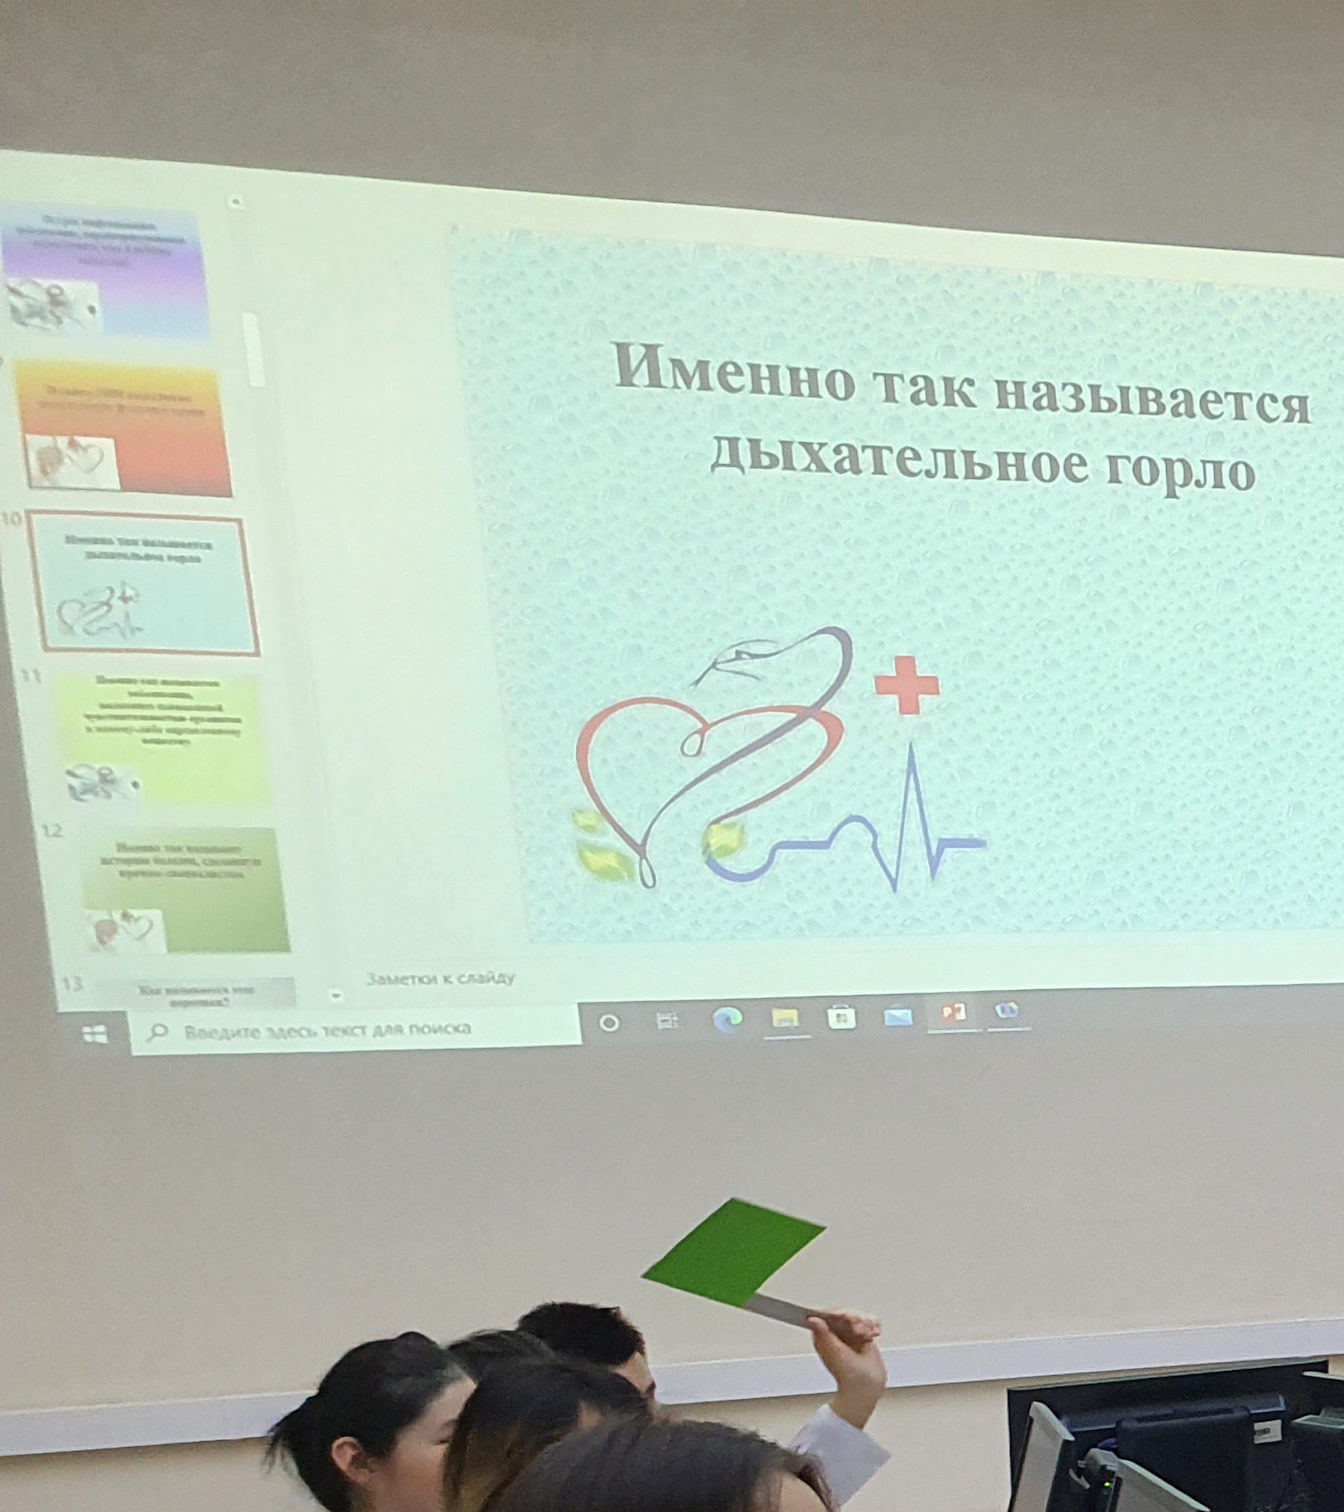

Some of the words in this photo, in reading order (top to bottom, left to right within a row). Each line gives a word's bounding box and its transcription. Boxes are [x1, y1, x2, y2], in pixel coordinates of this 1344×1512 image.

[610, 340, 857, 402] Именно
[872, 371, 978, 409] так
[994, 378, 1312, 425] называется
[710, 435, 1090, 484] дыхательное
[1103, 452, 1257, 500] горло
[42, 823, 64, 838] 12
[62, 975, 84, 992] 13
[366, 972, 438, 987] Заметки
[444, 974, 453, 985] к
[457, 971, 516, 987] слайду
[184, 1024, 262, 1041] Введите
[267, 1026, 317, 1040] здесь
[321, 1024, 367, 1038] текст
[372, 1024, 404, 1038] для
[409, 1021, 472, 1037] поиска
